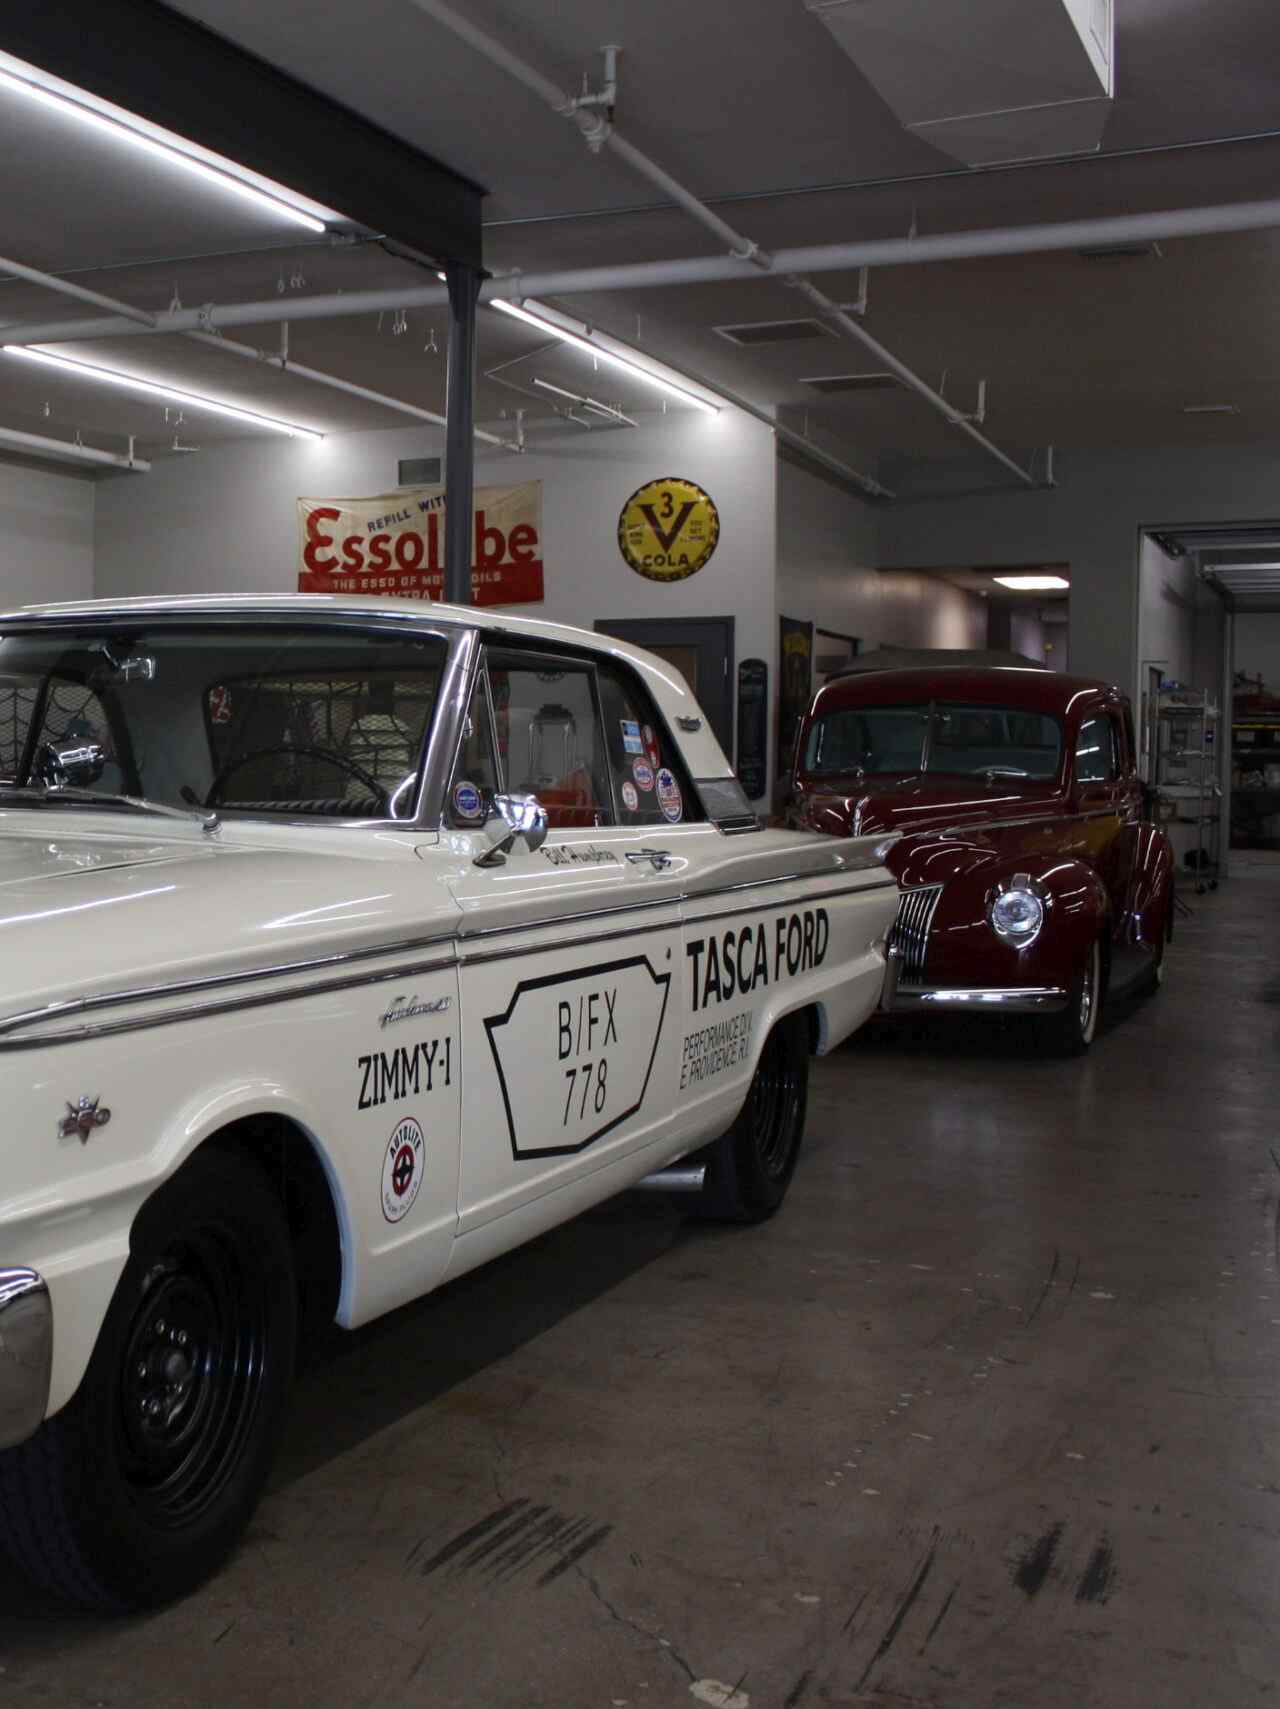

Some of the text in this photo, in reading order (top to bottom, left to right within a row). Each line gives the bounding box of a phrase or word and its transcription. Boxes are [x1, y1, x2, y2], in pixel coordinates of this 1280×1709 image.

[367, 508, 412, 532] REFILL
[636, 501, 700, 554] V
[660, 491, 674, 518] 3
[303, 507, 539, 574] Essolbe
[642, 553, 690, 568] COLA
[333, 578, 356, 590] THE
[360, 577, 396, 589] ESSO
[401, 575, 417, 587] OF
[686, 908, 829, 1012] TASCA FORD
[558, 988, 617, 1060] B/FX
[682, 1014, 739, 1062] PERFORMANCE
[564, 1058, 607, 1126] 778
[389, 1125, 421, 1160] AUTOLITE
